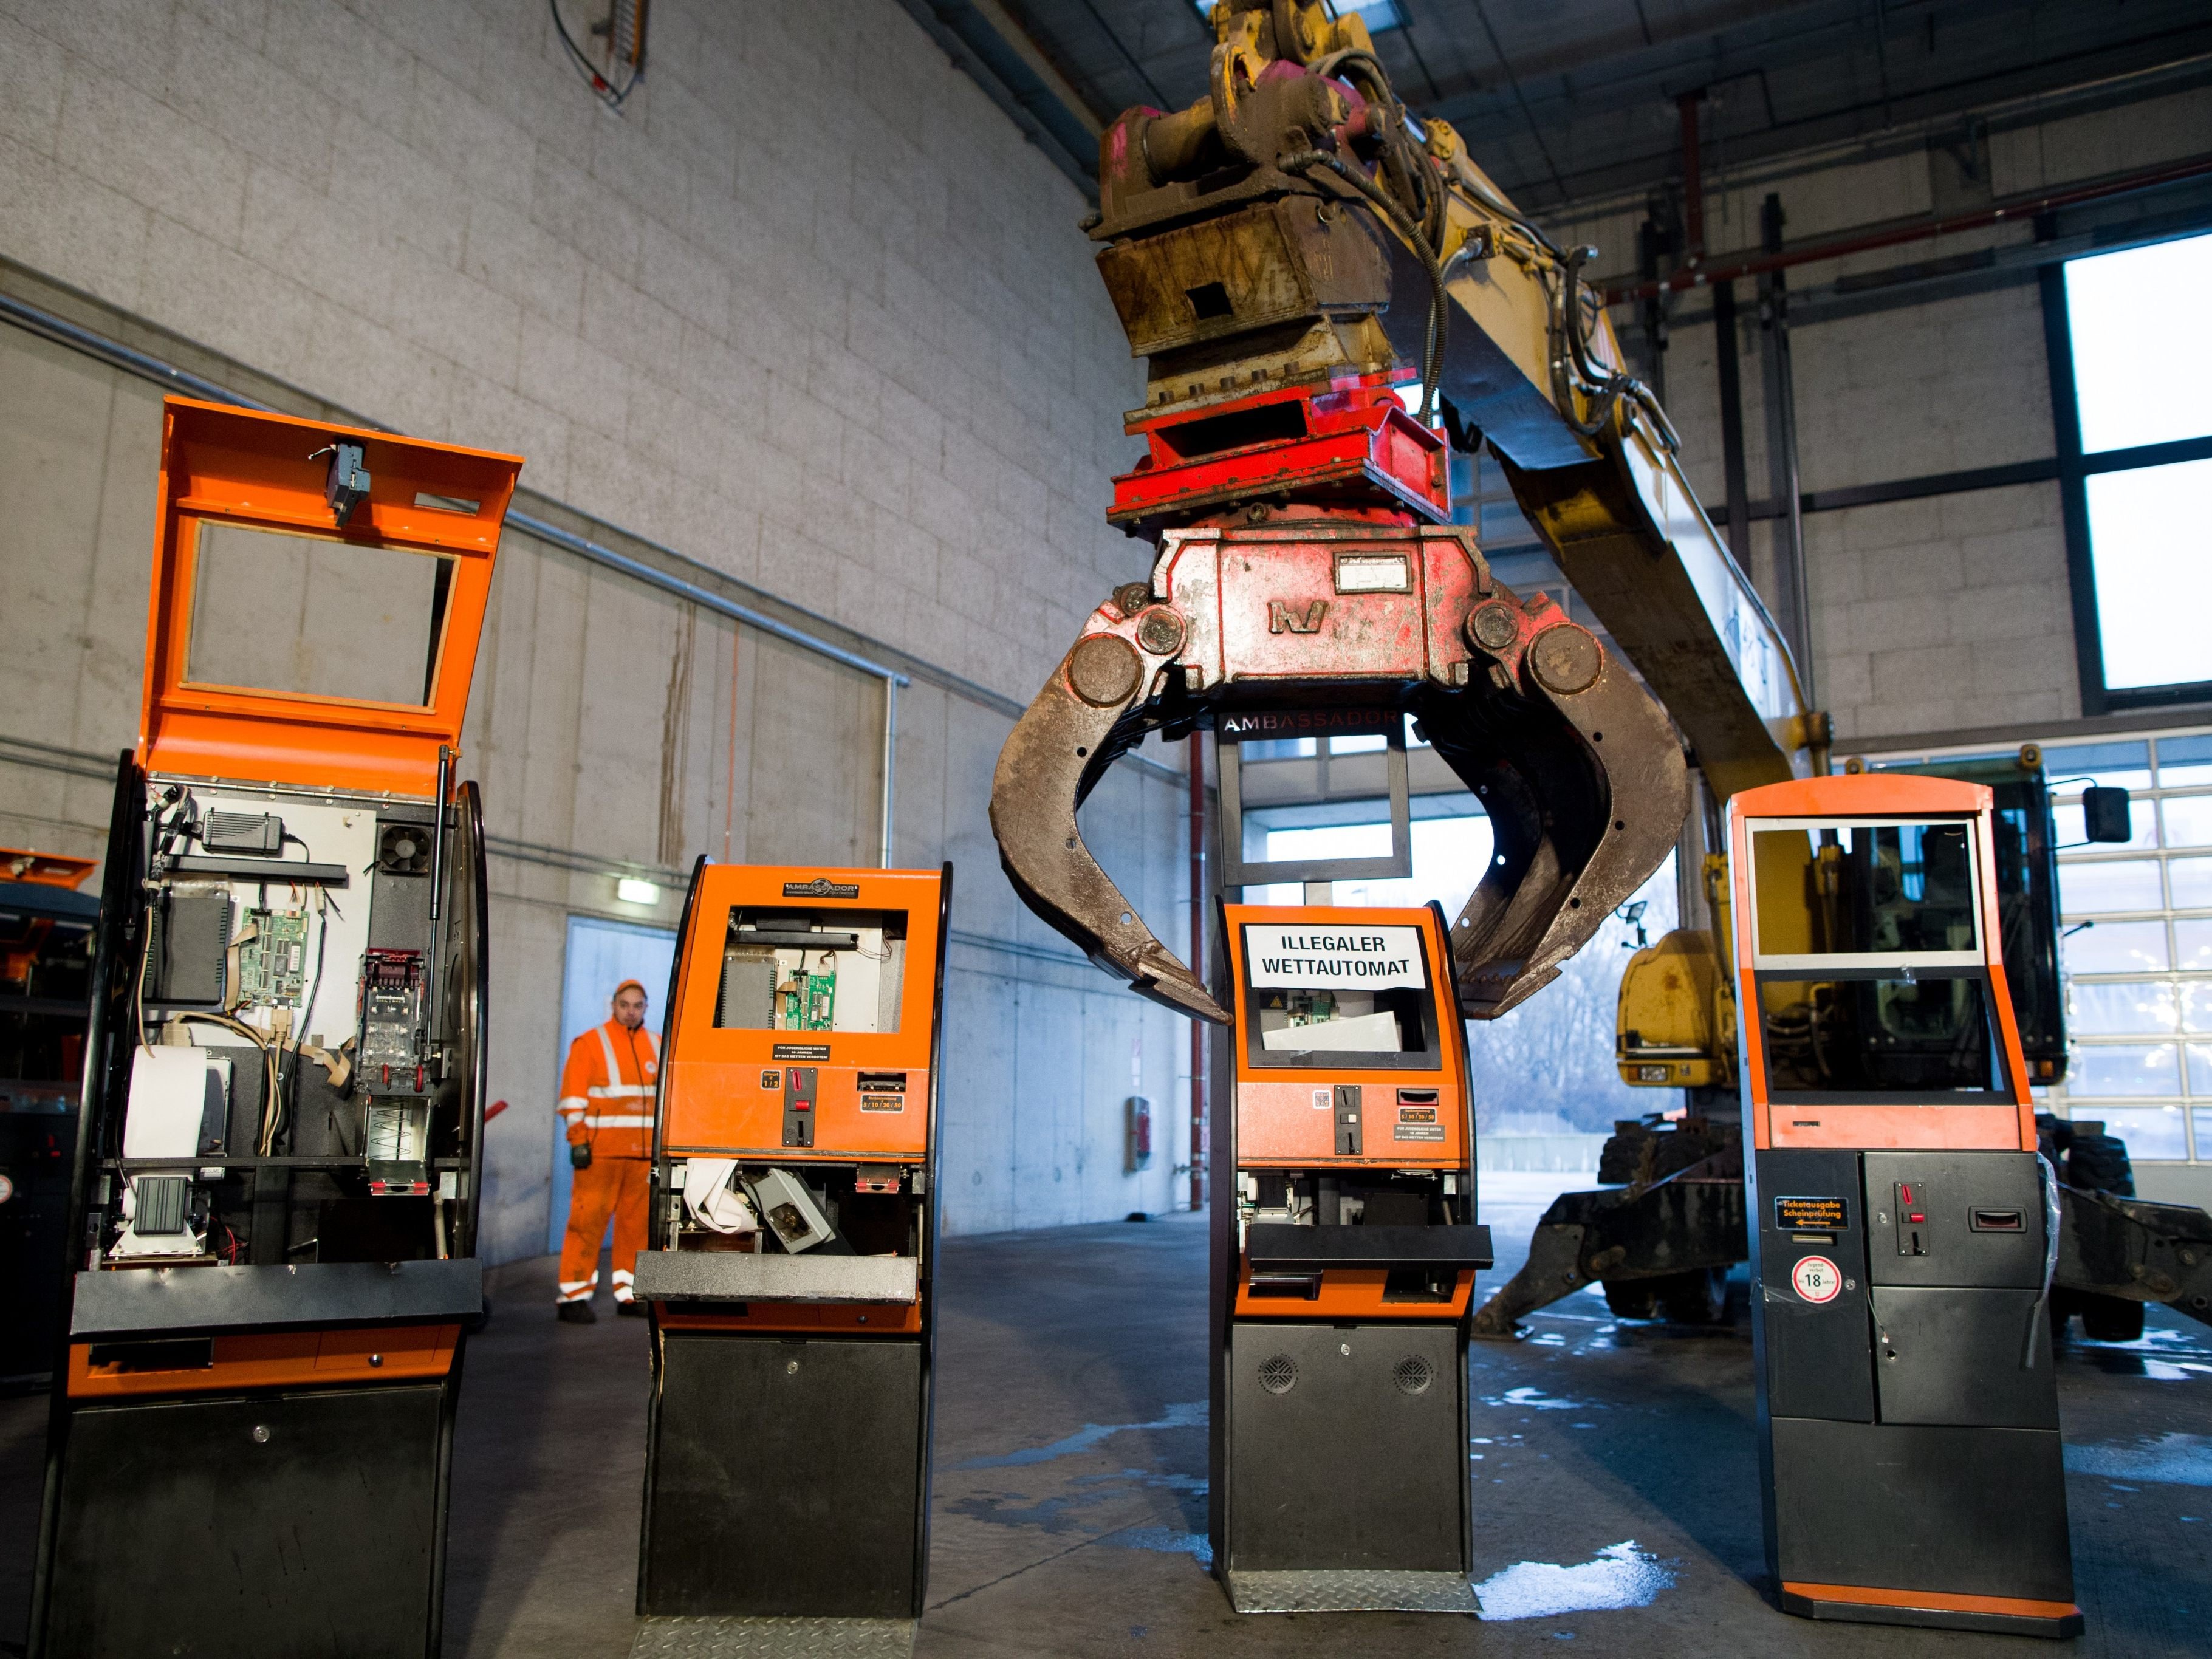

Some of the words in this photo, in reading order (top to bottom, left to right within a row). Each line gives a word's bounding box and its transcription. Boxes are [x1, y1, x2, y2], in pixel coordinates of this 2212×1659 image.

[1224, 710, 1398, 731] AMBASSADOR
[1282, 936, 1386, 952] ILLEGALER
[1262, 958, 1410, 976] WETTAUTOMAT
[1783, 1200, 1840, 1209] Ticketausgabe
[1783, 1209, 1841, 1219] Scheinprüfung
[1804, 1274, 1821, 1287] 18
